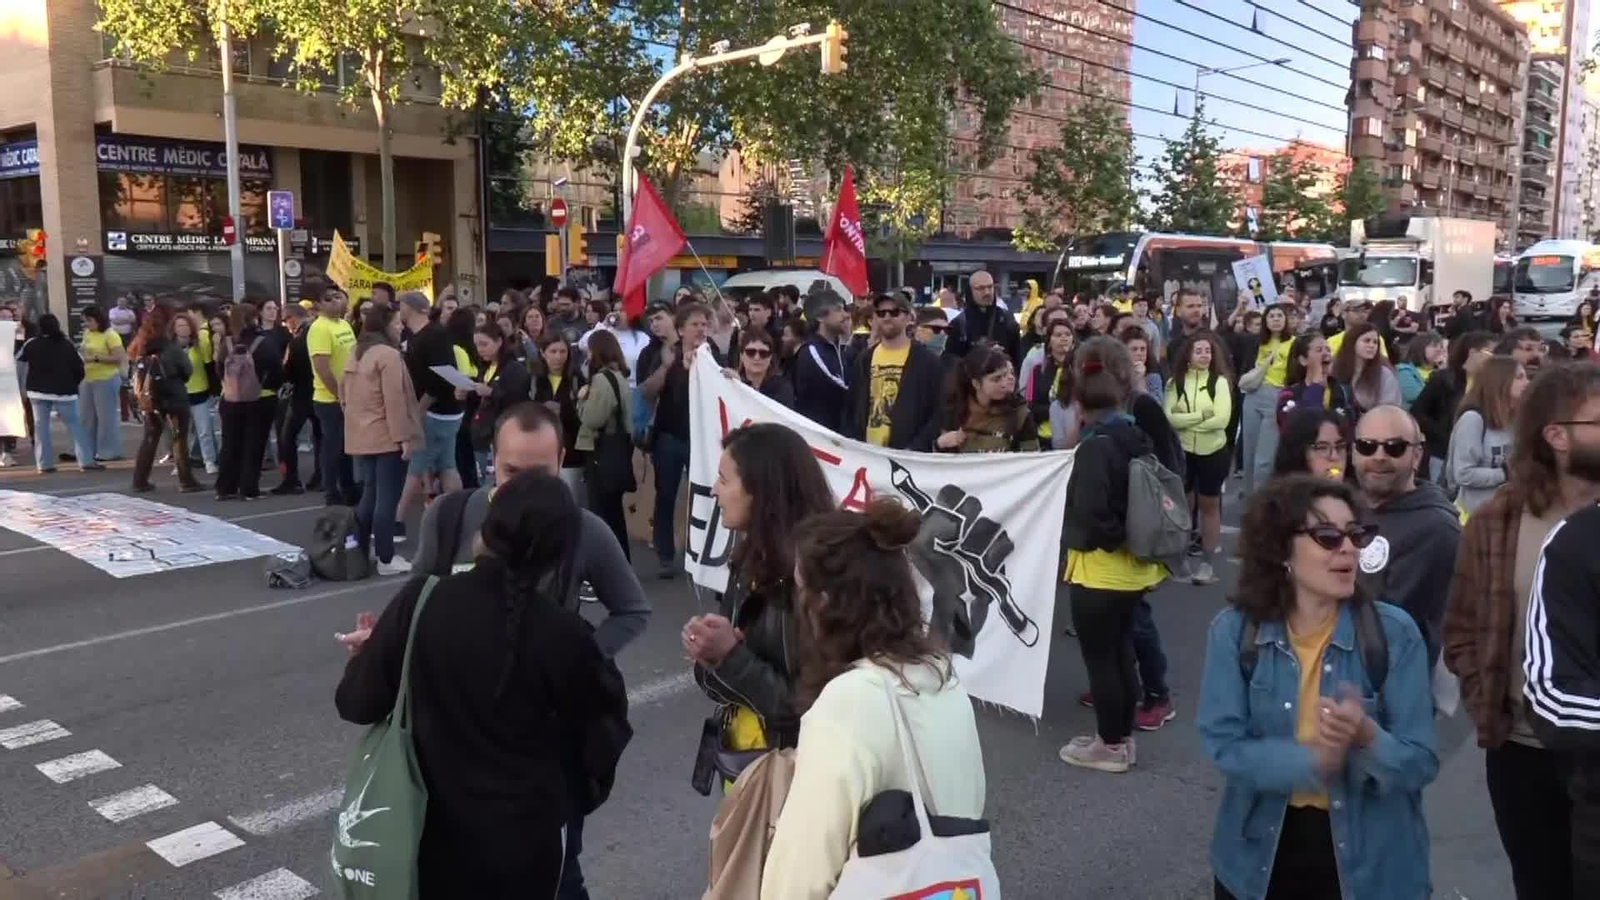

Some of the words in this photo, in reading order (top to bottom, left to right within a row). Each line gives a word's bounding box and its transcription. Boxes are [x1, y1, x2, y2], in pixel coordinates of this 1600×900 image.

[97, 143, 156, 162] CENTRE
[217, 151, 269, 169] CTALÀ
[131, 234, 172, 244] CENTRE
[214, 236, 226, 244] LA
[245, 237, 276, 246] MPANA
[840, 212, 865, 258] ONTR
[344, 867, 375, 887] ONE
